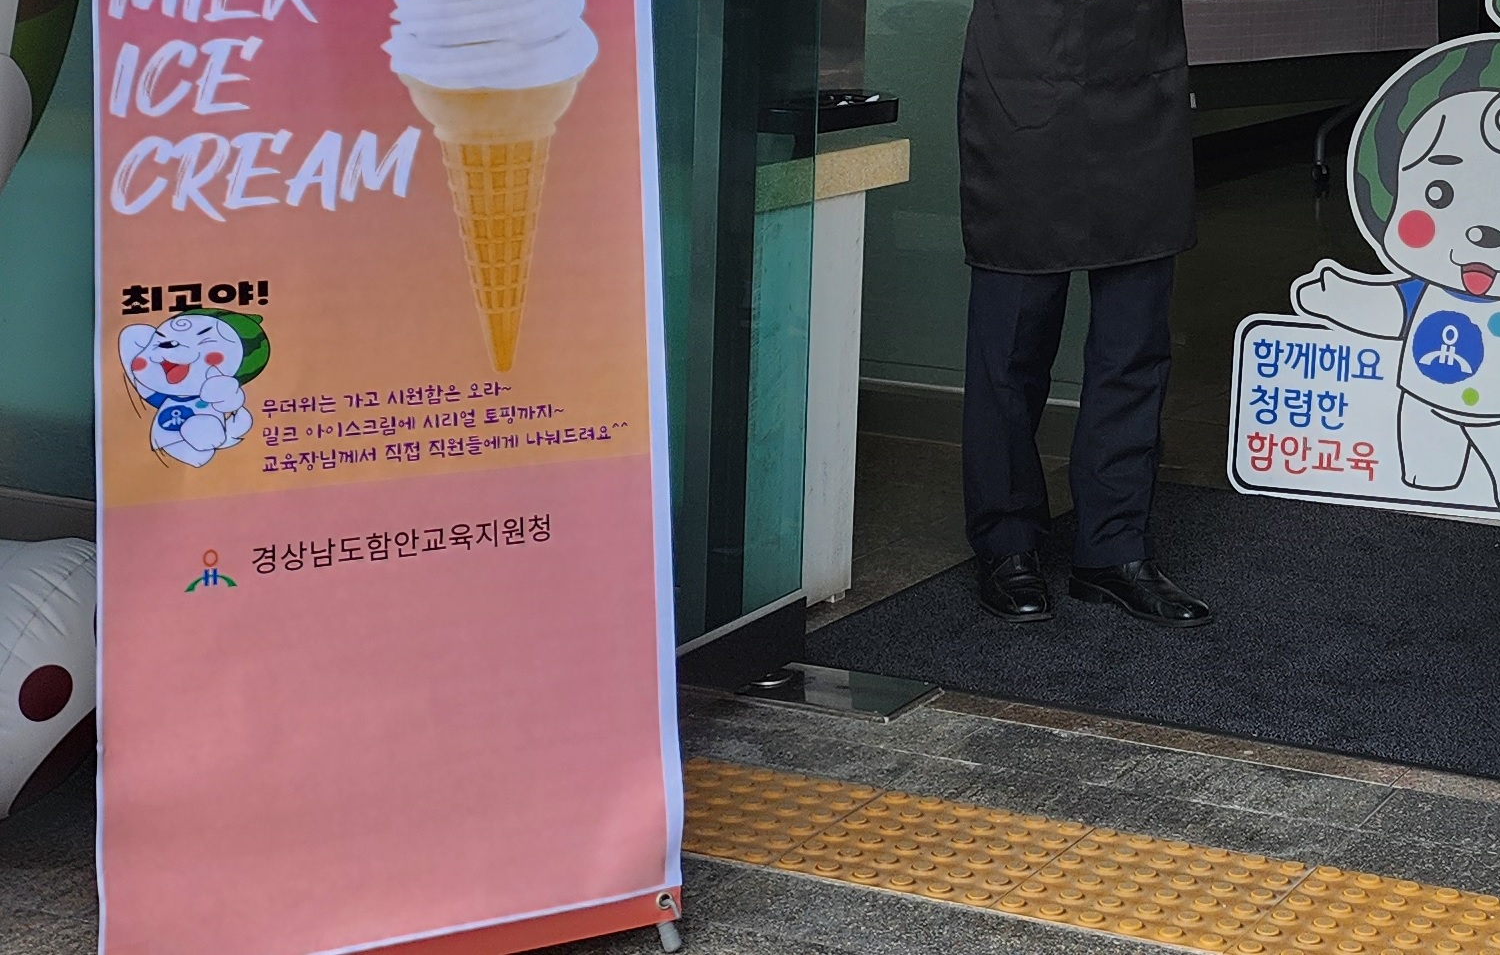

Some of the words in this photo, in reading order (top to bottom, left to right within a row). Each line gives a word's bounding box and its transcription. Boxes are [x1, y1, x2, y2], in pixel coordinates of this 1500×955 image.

[109, 36, 263, 118] ICE
[110, 126, 421, 222] CREAM
[121, 280, 270, 316] 최고야!
[1253, 339, 1384, 382] 함께해요
[262, 396, 336, 418] 무더위는
[344, 391, 380, 409] 가고
[387, 385, 461, 406] 시원함은
[467, 382, 512, 399] 오라~
[1249, 385, 1348, 430] 청렴한
[263, 425, 299, 447] 밀크
[306, 415, 415, 440] 아이스크림에
[423, 408, 476, 429] 시리얼
[484, 404, 564, 425] 토핑까지~
[262, 448, 377, 473] 교육장님께서
[385, 442, 421, 463] 직접
[429, 435, 519, 458] 직원들에게
[1246, 431, 1379, 481] 함안교육
[251, 513, 553, 575] 경상남도함안교육지원청
